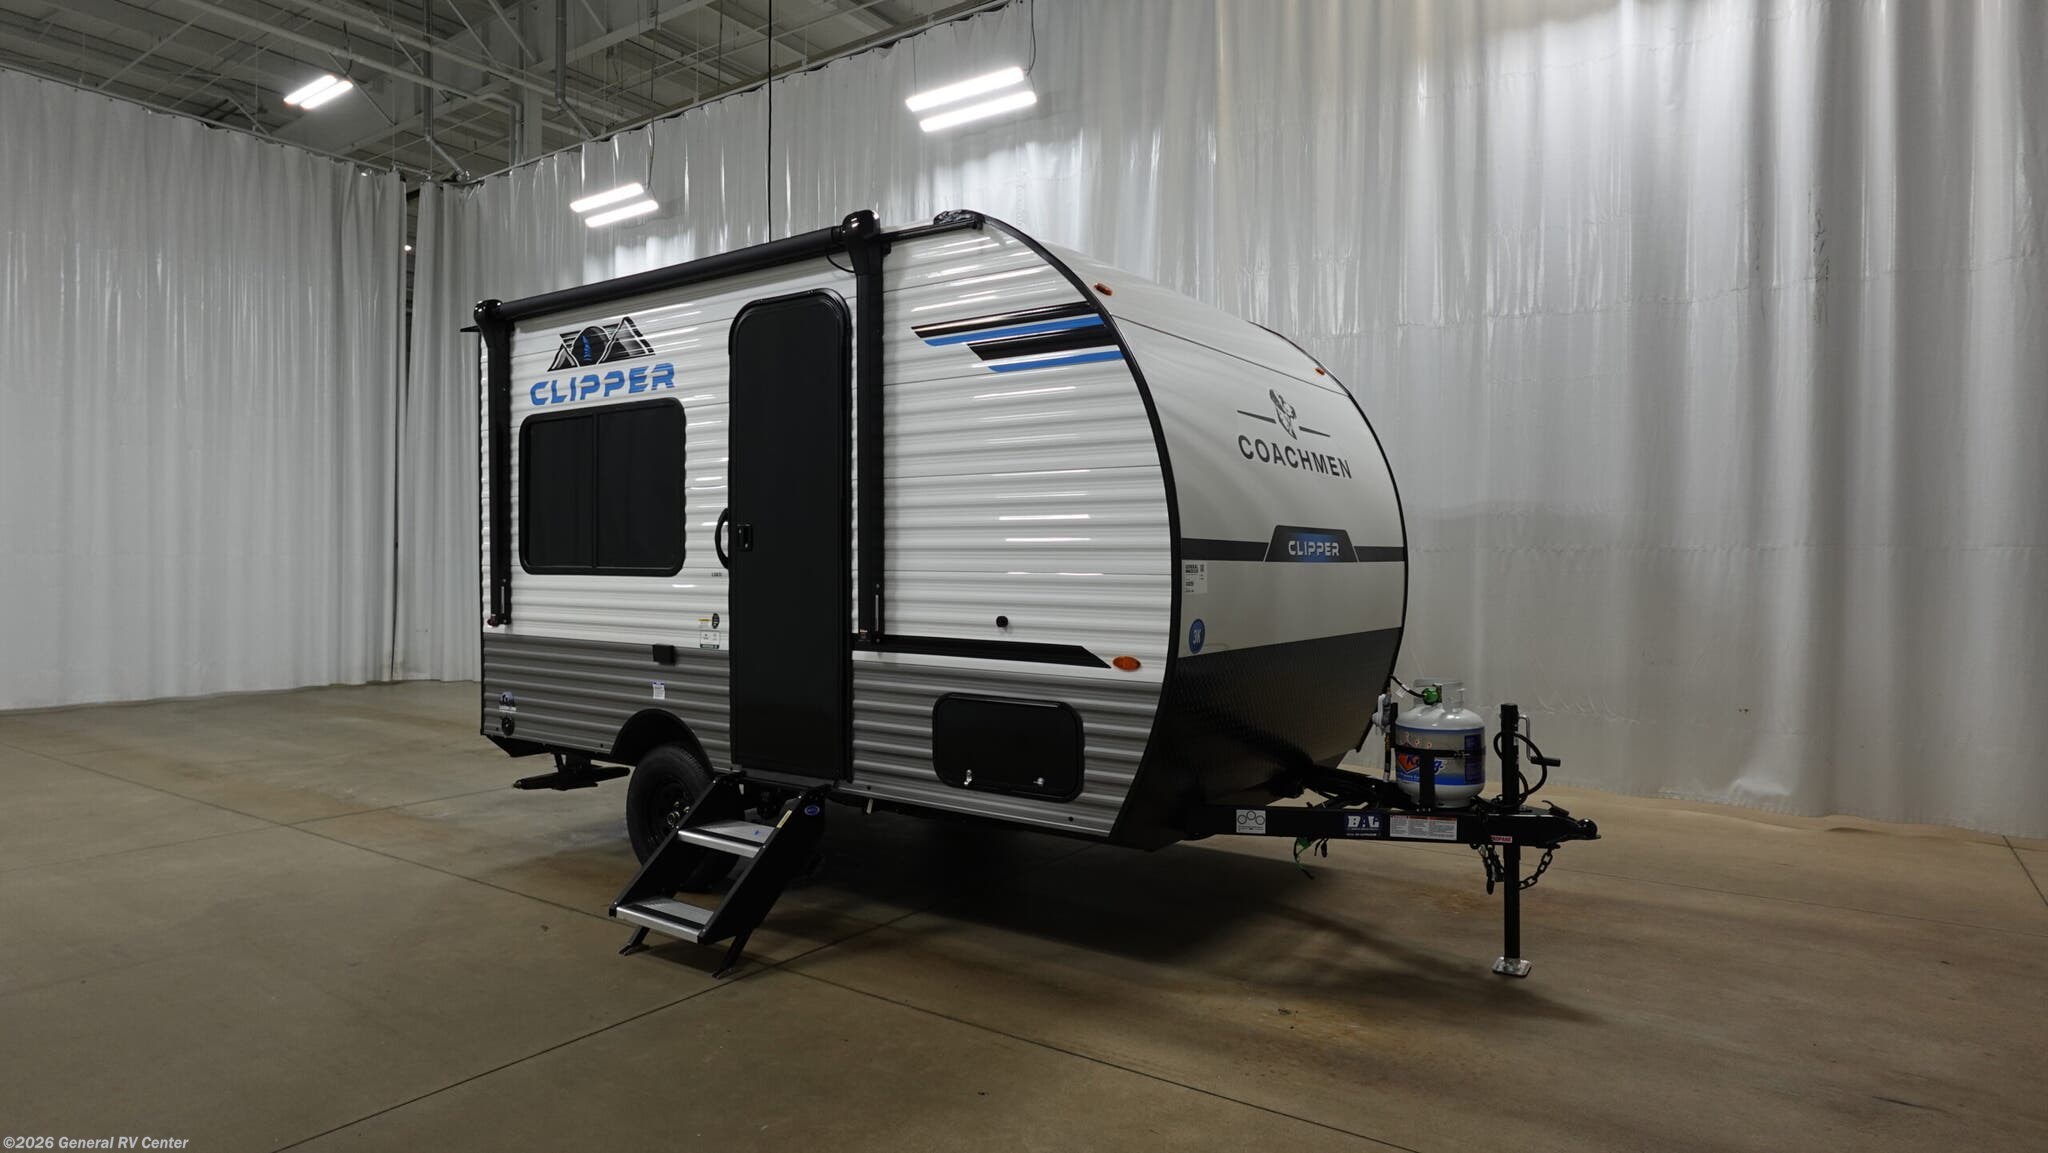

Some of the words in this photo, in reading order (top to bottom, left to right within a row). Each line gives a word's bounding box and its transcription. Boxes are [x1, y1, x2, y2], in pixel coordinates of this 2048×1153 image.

[530, 362, 675, 406] CLIPPER
[1238, 434, 1352, 479] COACHMEN
[1288, 540, 1340, 556] CLIPPER
